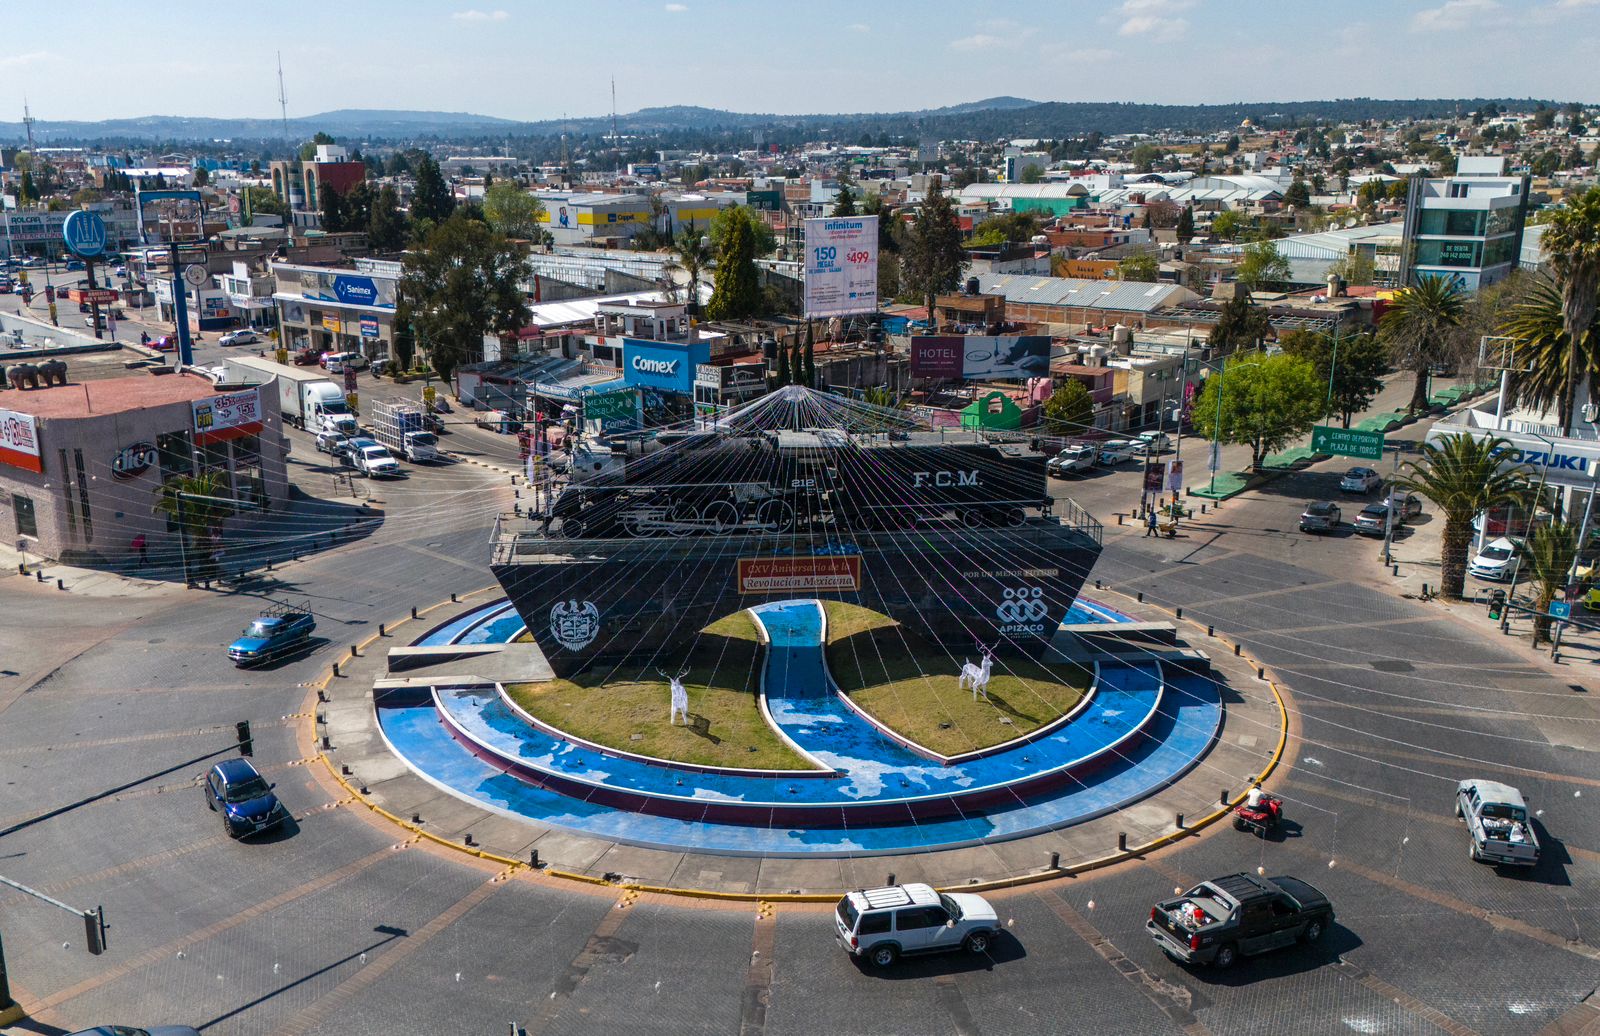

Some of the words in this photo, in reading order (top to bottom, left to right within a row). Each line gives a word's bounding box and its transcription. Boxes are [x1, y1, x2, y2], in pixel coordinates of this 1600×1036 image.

[11, 216, 42, 224] ROLCAR
[825, 220, 863, 230] infinitum
[814, 246, 837, 261] 150
[846, 251, 869, 264] $499
[346, 284, 371, 295] Sanimex
[919, 349, 957, 358] HOTEL
[632, 355, 677, 374] Comex
[605, 419, 630, 430] Comex
[1331, 432, 1350, 441] CENTRO
[1352, 434, 1379, 445] DEPORTIVO
[1330, 442, 1348, 451] PLAZA
[1349, 445, 1357, 453] DE
[1359, 446, 1377, 455] TOROS
[113, 448, 159, 471] dico
[791, 478, 815, 487] 212
[771, 562, 826, 573] Aniversario
[828, 562, 839, 571] de
[841, 561, 852, 570] la
[746, 577, 801, 588] Revolución
[803, 575, 853, 586] Mexicana
[1000, 624, 1044, 632] APIZACO
